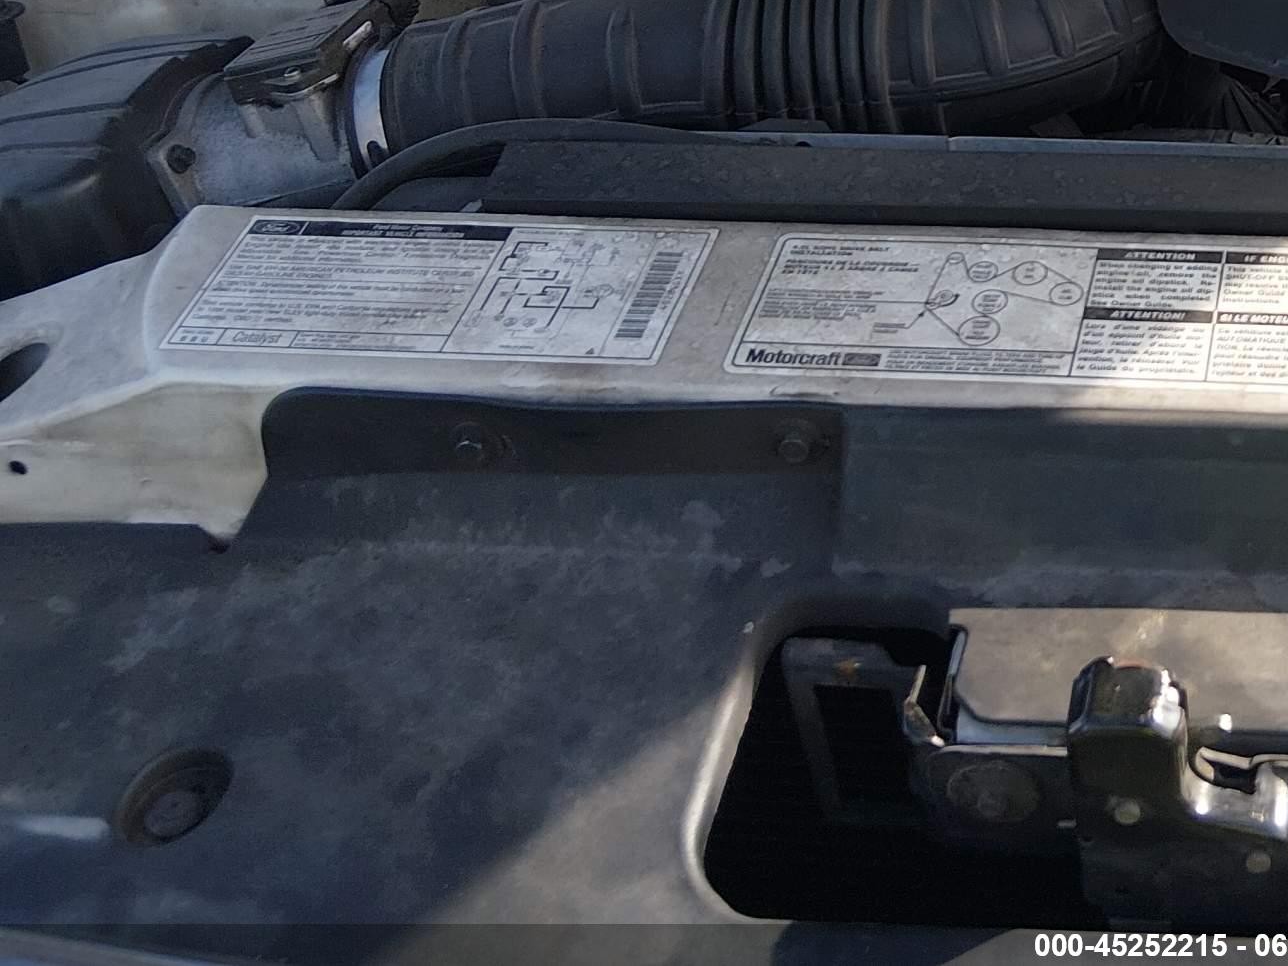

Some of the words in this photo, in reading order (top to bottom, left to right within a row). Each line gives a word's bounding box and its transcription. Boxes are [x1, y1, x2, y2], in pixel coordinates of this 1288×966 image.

[1124, 251, 1195, 259] ATTENTION
[1232, 314, 1249, 322] LE
[232, 330, 282, 346] Catalyst
[745, 347, 842, 367] Motorcraft
